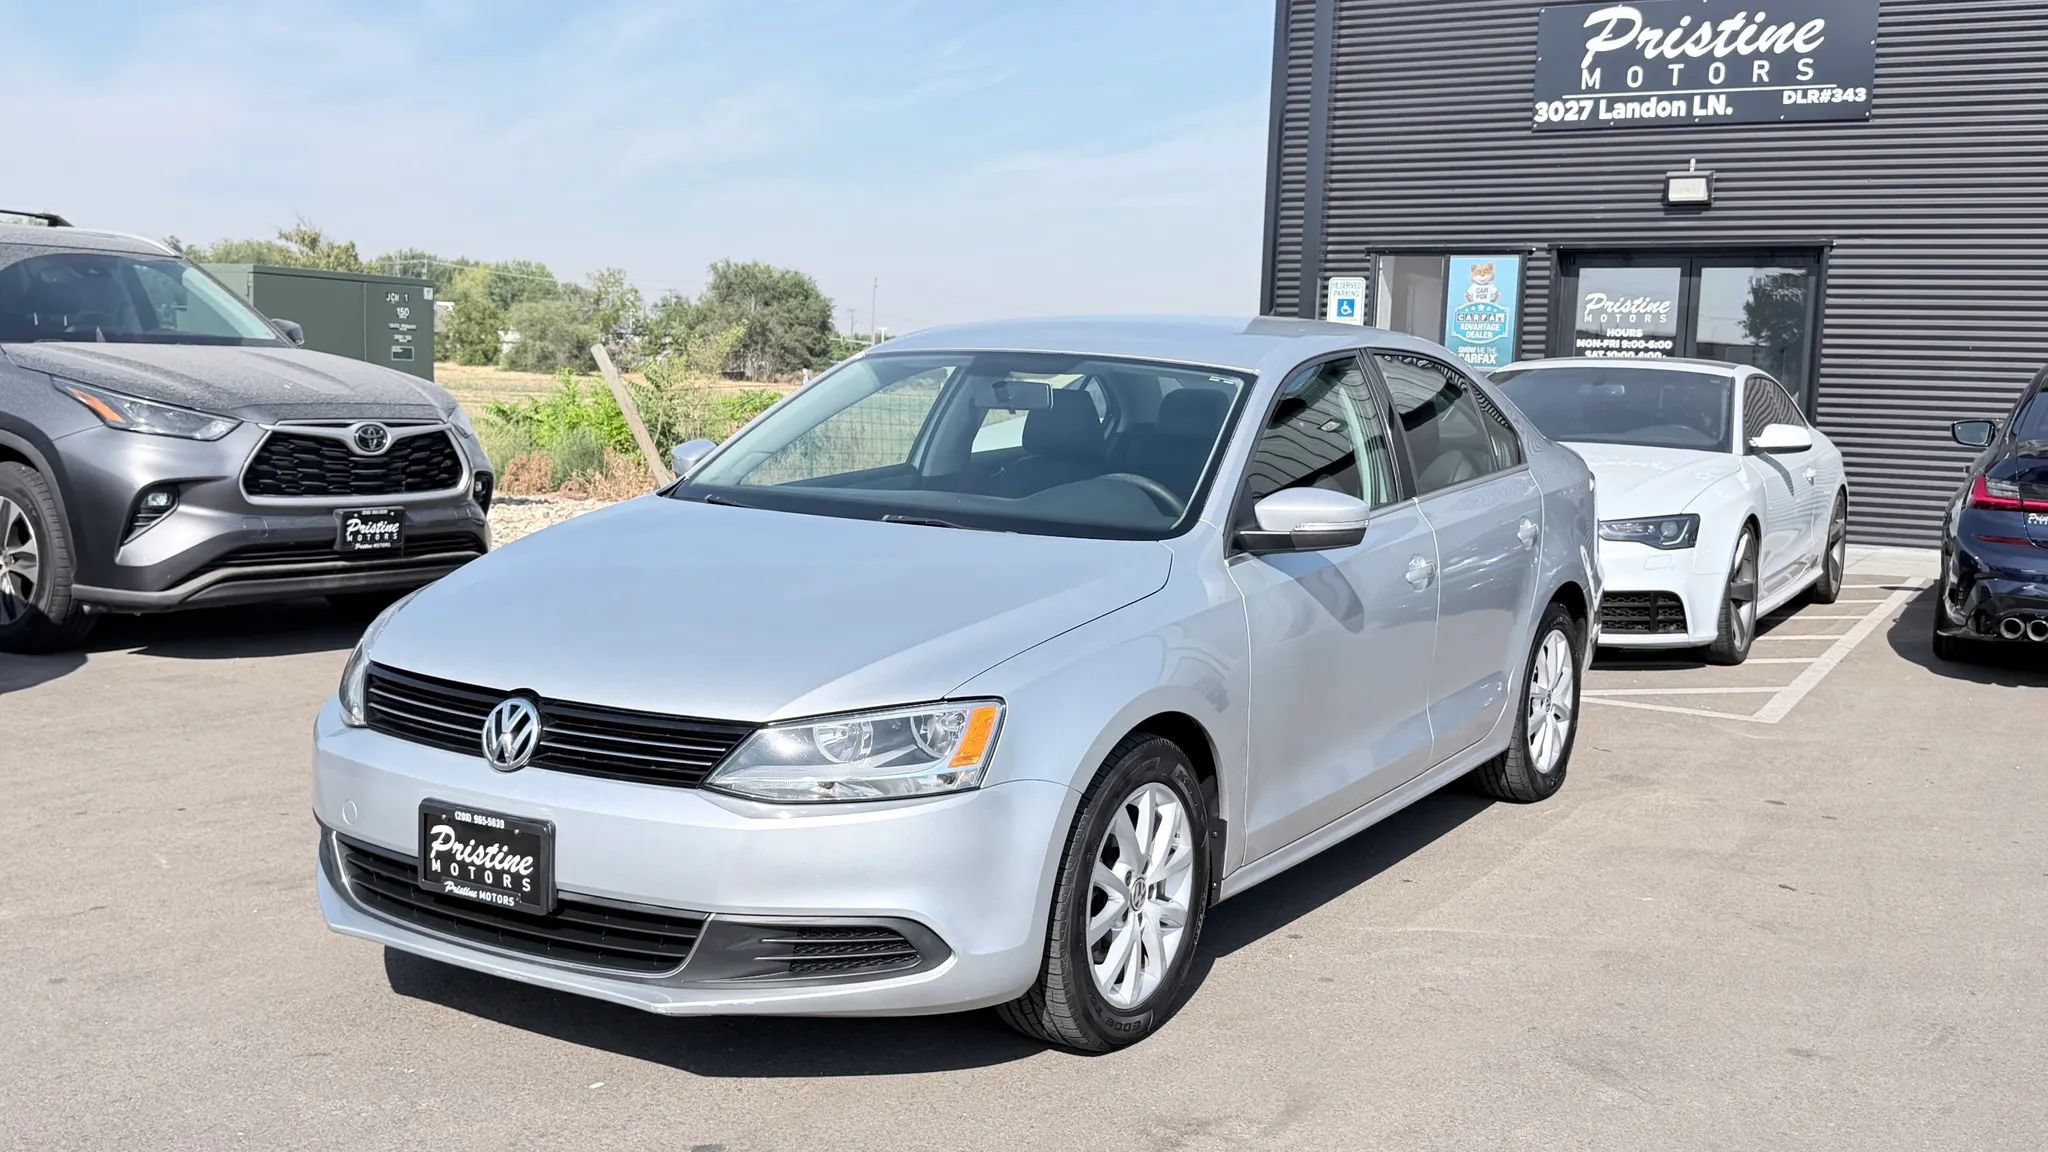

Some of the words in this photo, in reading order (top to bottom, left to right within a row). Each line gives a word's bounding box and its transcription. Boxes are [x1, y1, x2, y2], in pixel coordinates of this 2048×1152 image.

[1580, 5, 1826, 70] Pristine
[1580, 57, 1815, 91] MOTORS
[1782, 87, 1867, 106] DLR#343
[1534, 100, 1595, 123] 3027
[1598, 97, 1687, 121] Landon
[1692, 94, 1734, 117] LN.
[1584, 293, 1670, 315] Pristine
[1584, 313, 1667, 323] MOTORS
[1576, 339, 1619, 348] MON-FRI
[1621, 340, 1672, 349] 9:00-6:00
[1607, 329, 1643, 337] HOURS
[346, 518, 399, 536] Pristine
[346, 533, 398, 542] MOTORS
[430, 824, 534, 876] Pristine
[431, 858, 532, 893] MOTORS
[443, 880, 478, 899] Pristine
[478, 890, 515, 907] MOTORS
